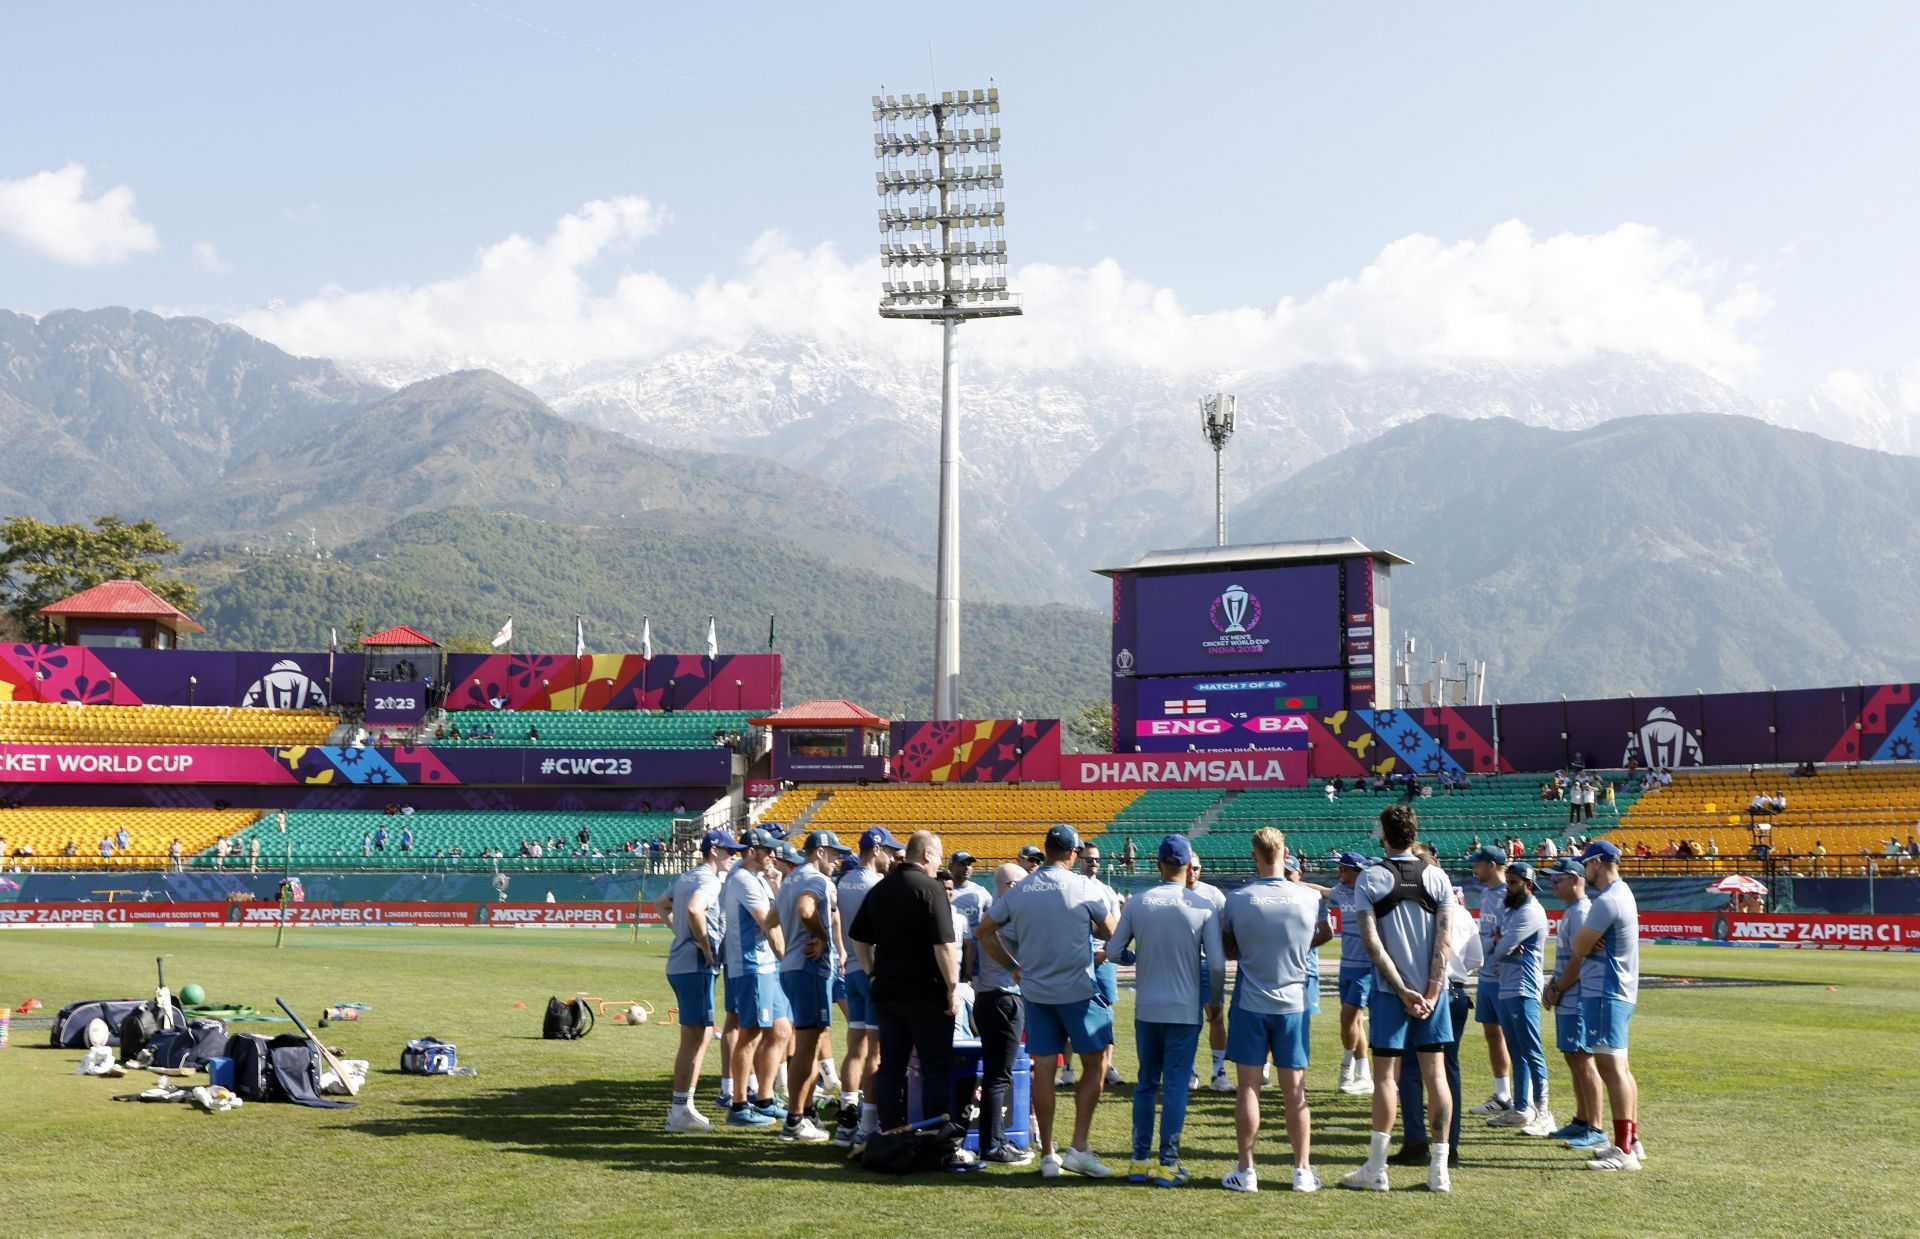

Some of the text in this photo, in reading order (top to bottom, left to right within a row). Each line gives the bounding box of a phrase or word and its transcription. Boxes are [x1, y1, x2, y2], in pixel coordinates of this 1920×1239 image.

[1208, 646, 1235, 654] INDIA
[1200, 683, 1238, 691] MATCH
[1152, 719, 1221, 734] ENG
[57, 755, 142, 773] WORLD
[147, 755, 193, 773] CUP
[540, 758, 632, 775] #CWC23
[1080, 760, 1285, 783] DHARAMSALA
[1022, 882, 1067, 893] ENGLAND
[1142, 897, 1192, 907] ENGLAND
[0, 909, 35, 922] RF
[37, 909, 104, 922] ZAPPER
[171, 911, 201, 919] SCOOTER
[202, 911, 219, 919] TYRE
[244, 908, 298, 921] MRF
[300, 908, 360, 921] ZAPPER
[492, 909, 542, 921] MRF
[544, 909, 602, 921] ZAPPER
[1650, 924, 1683, 932] SCOOTER
[1684, 925, 1703, 933] TYRE
[1732, 922, 1795, 938] MRF
[1798, 923, 1873, 940] ZAPPER
